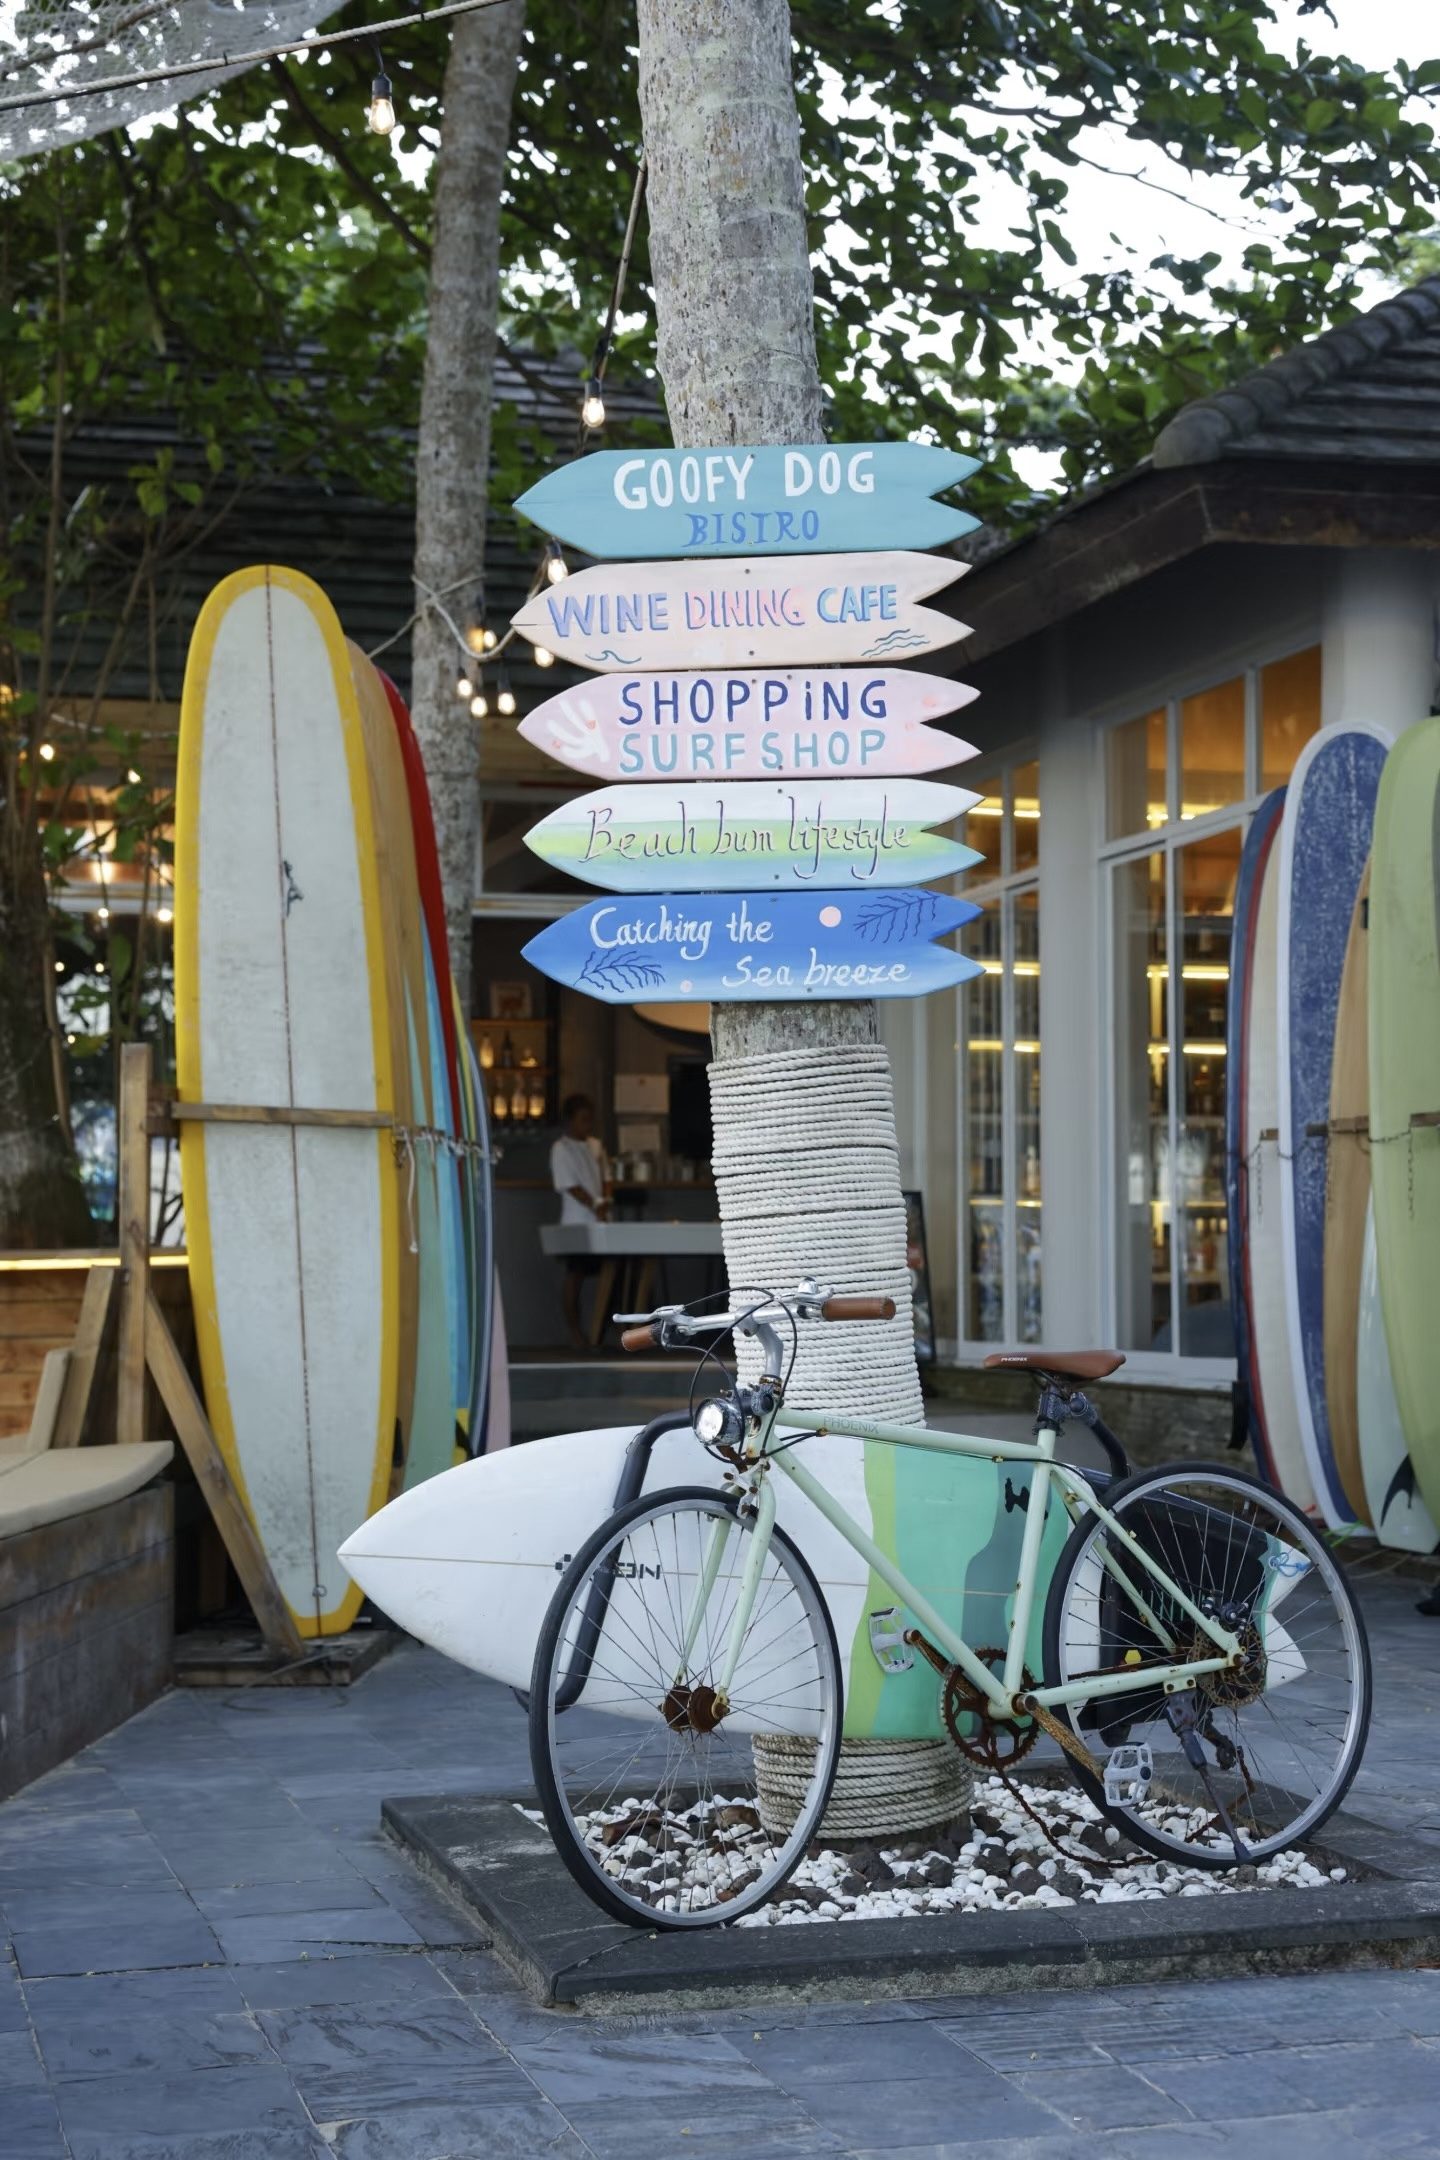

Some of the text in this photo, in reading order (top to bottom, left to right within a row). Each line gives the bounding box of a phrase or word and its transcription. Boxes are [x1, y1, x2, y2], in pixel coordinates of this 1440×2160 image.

[614, 451, 875, 510] GOOFY DOG
[684, 510, 819, 547] BISTRO
[547, 584, 897, 637] WINE DINING CAFE
[578, 794, 912, 880] Beach bum lifestyle
[589, 900, 774, 961] Catching the
[722, 947, 912, 988] Sea breeze
[823, 1416, 880, 1434] PHOENIX
